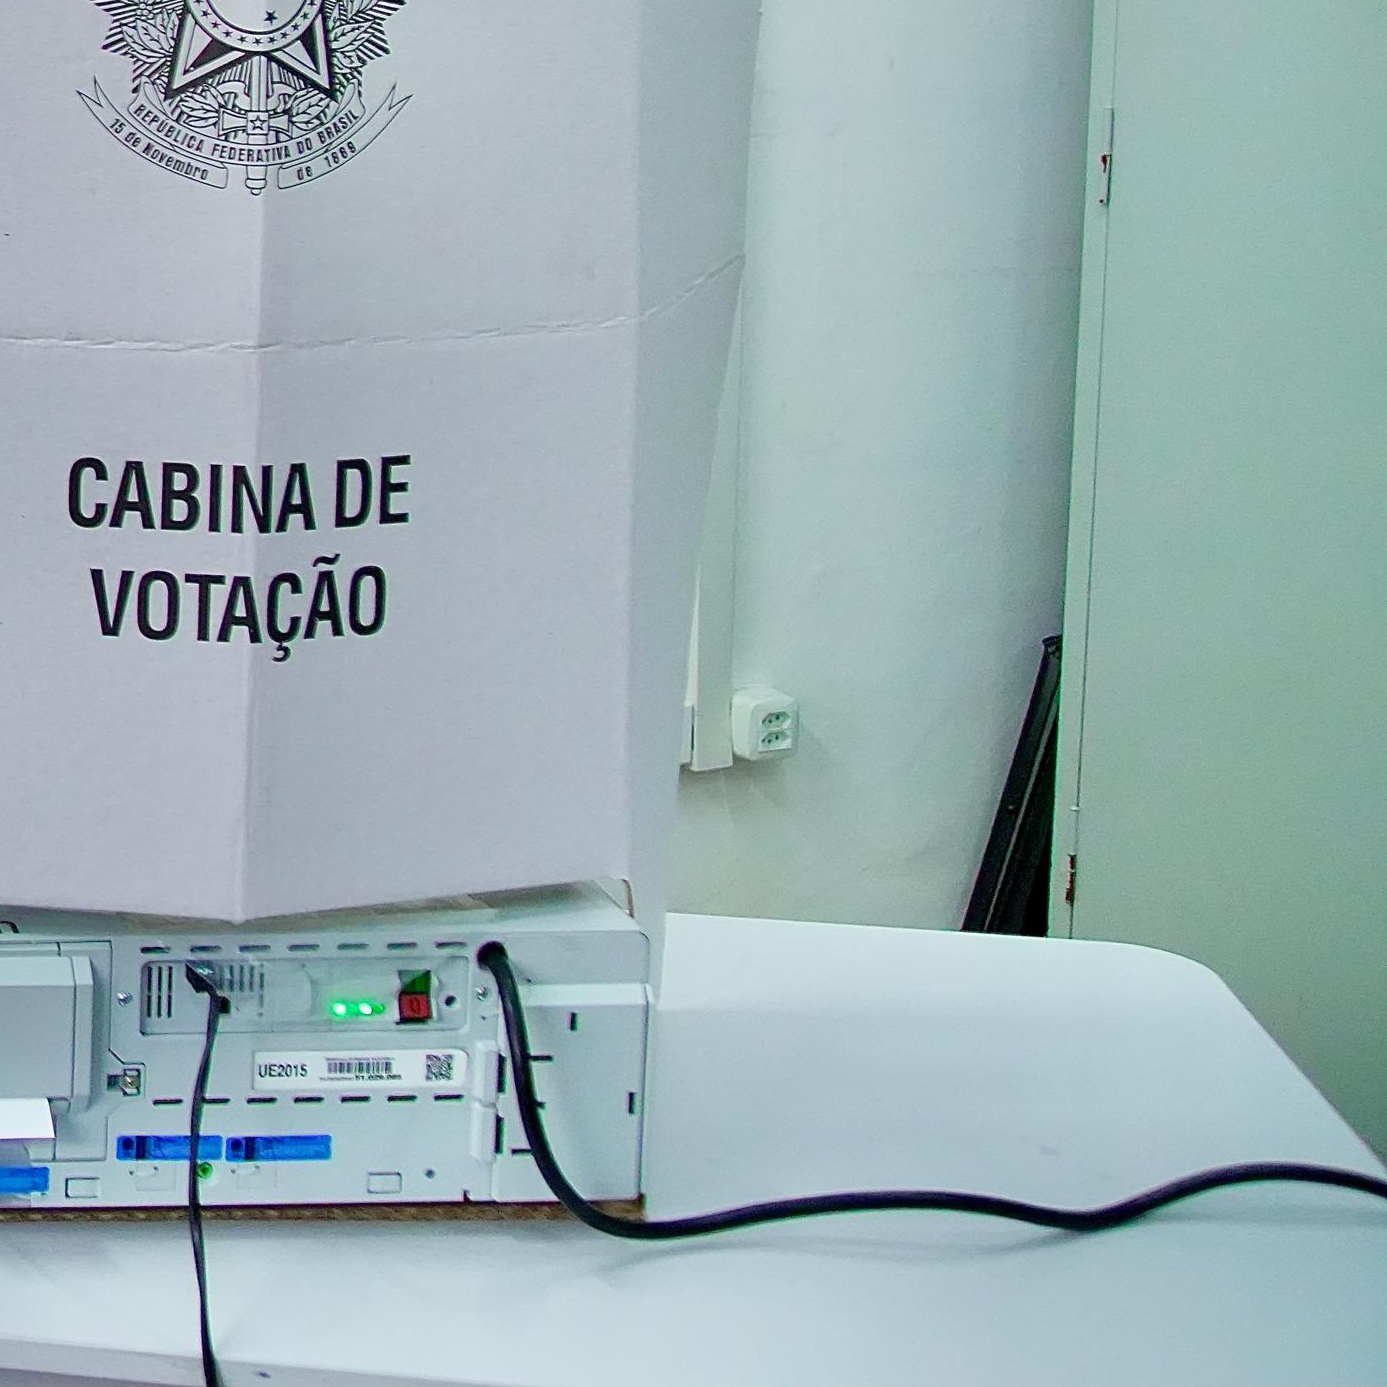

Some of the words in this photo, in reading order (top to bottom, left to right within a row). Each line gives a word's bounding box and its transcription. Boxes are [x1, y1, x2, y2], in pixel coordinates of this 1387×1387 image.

[108, 118, 124, 136] 15
[124, 131, 142, 145] de
[143, 143, 209, 181] Novembro
[296, 165, 314, 181] de
[133, 104, 203, 152] REPÚBLICA
[211, 143, 291, 162] FEDERATIVA
[296, 140, 313, 155] DO
[319, 110, 360, 144] BRASIL
[68, 456, 317, 534] CABINA
[335, 454, 412, 529] DE
[90, 553, 387, 662] VOTAÇÃO
[258, 1064, 308, 1078] UE2015
